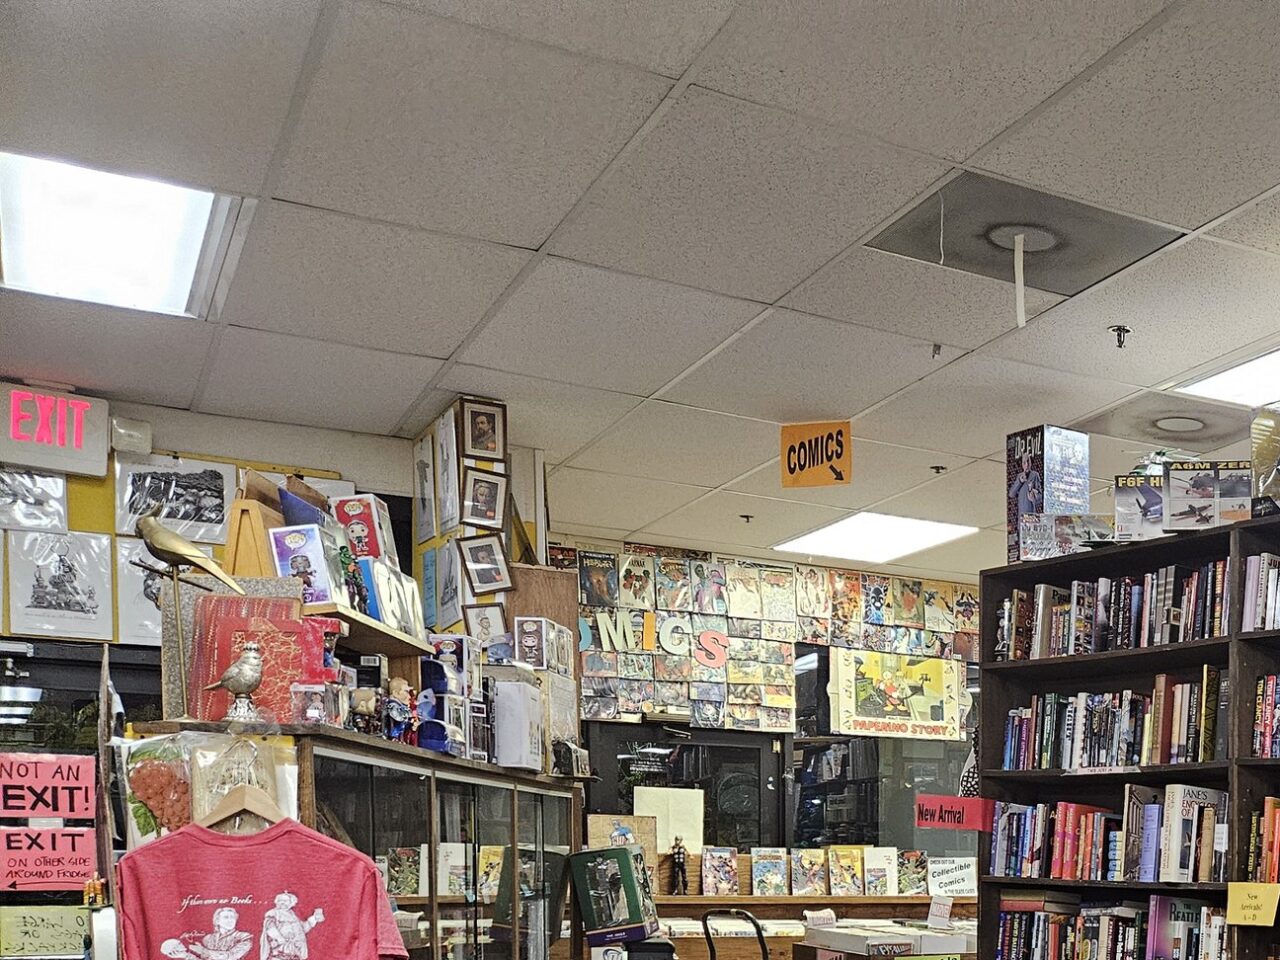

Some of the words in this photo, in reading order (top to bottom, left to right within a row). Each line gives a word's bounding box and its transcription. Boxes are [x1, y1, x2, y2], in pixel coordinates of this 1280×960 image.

[10, 390, 91, 449] EXIT
[786, 428, 845, 475] COMICS
[1170, 461, 1211, 471] A6M
[1216, 461, 1250, 471] ZER
[1118, 476, 1145, 488] F6F
[1256, 679, 1264, 695] TOM
[1254, 696, 1263, 724] CLANCY
[1264, 696, 1272, 725] CLANCY
[852, 719, 909, 734] PAPERINO
[910, 723, 949, 736] STORY
[0, 760, 45, 780] NOT
[52, 764, 81, 782] AN
[2, 784, 90, 813] EXIT!
[1182, 788, 1209, 800] JANE'S
[917, 803, 936, 822] New
[937, 804, 965, 825] Arrival
[6, 832, 85, 852] EXIT
[7, 857, 28, 868] ON
[34, 856, 67, 868] OTHER
[931, 861, 972, 879] Collectible
[5, 868, 54, 880] AROUND
[937, 875, 966, 890] Comics
